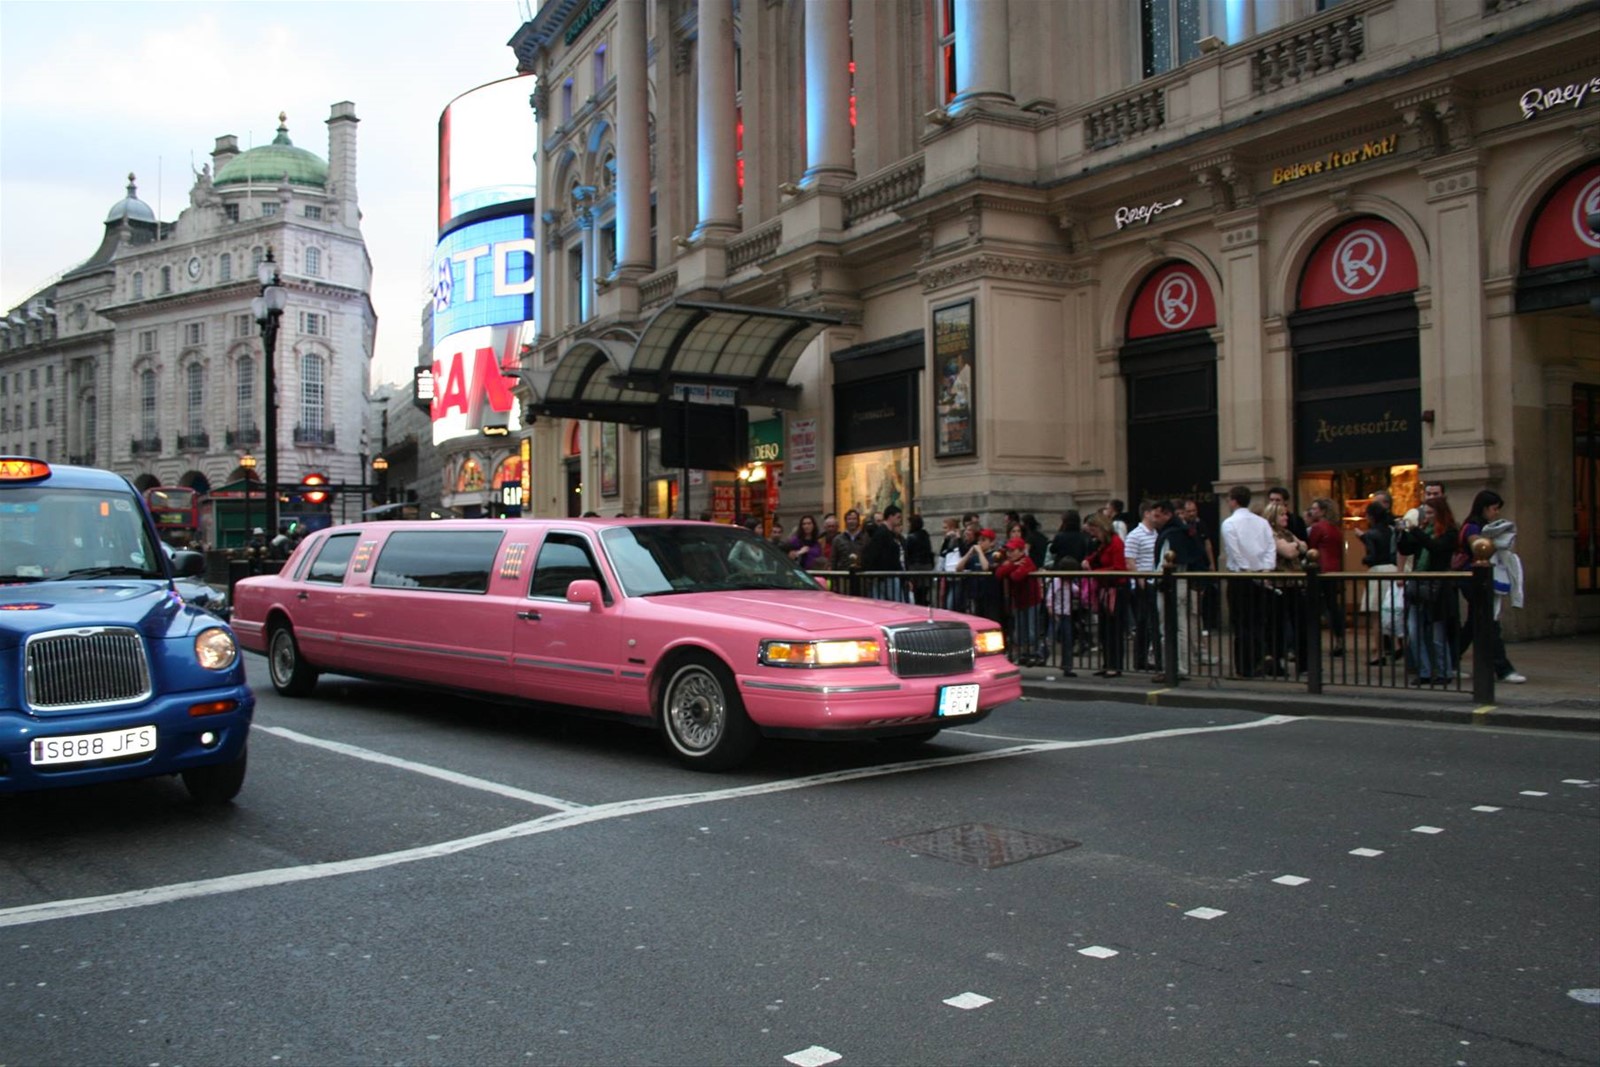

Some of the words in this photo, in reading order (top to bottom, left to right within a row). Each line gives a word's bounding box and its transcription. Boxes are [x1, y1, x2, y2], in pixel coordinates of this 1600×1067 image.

[1272, 159, 1323, 185] Believe
[1325, 151, 1341, 171] It
[1342, 149, 1359, 165] or
[1361, 133, 1398, 161] Not!
[1314, 410, 1408, 443] Accessorize
[503, 486, 523, 506] GAP
[714, 486, 752, 498] TICKTS
[729, 499, 752, 511] SLE
[47, 737, 104, 759] S888
[112, 730, 150, 752] JFS
